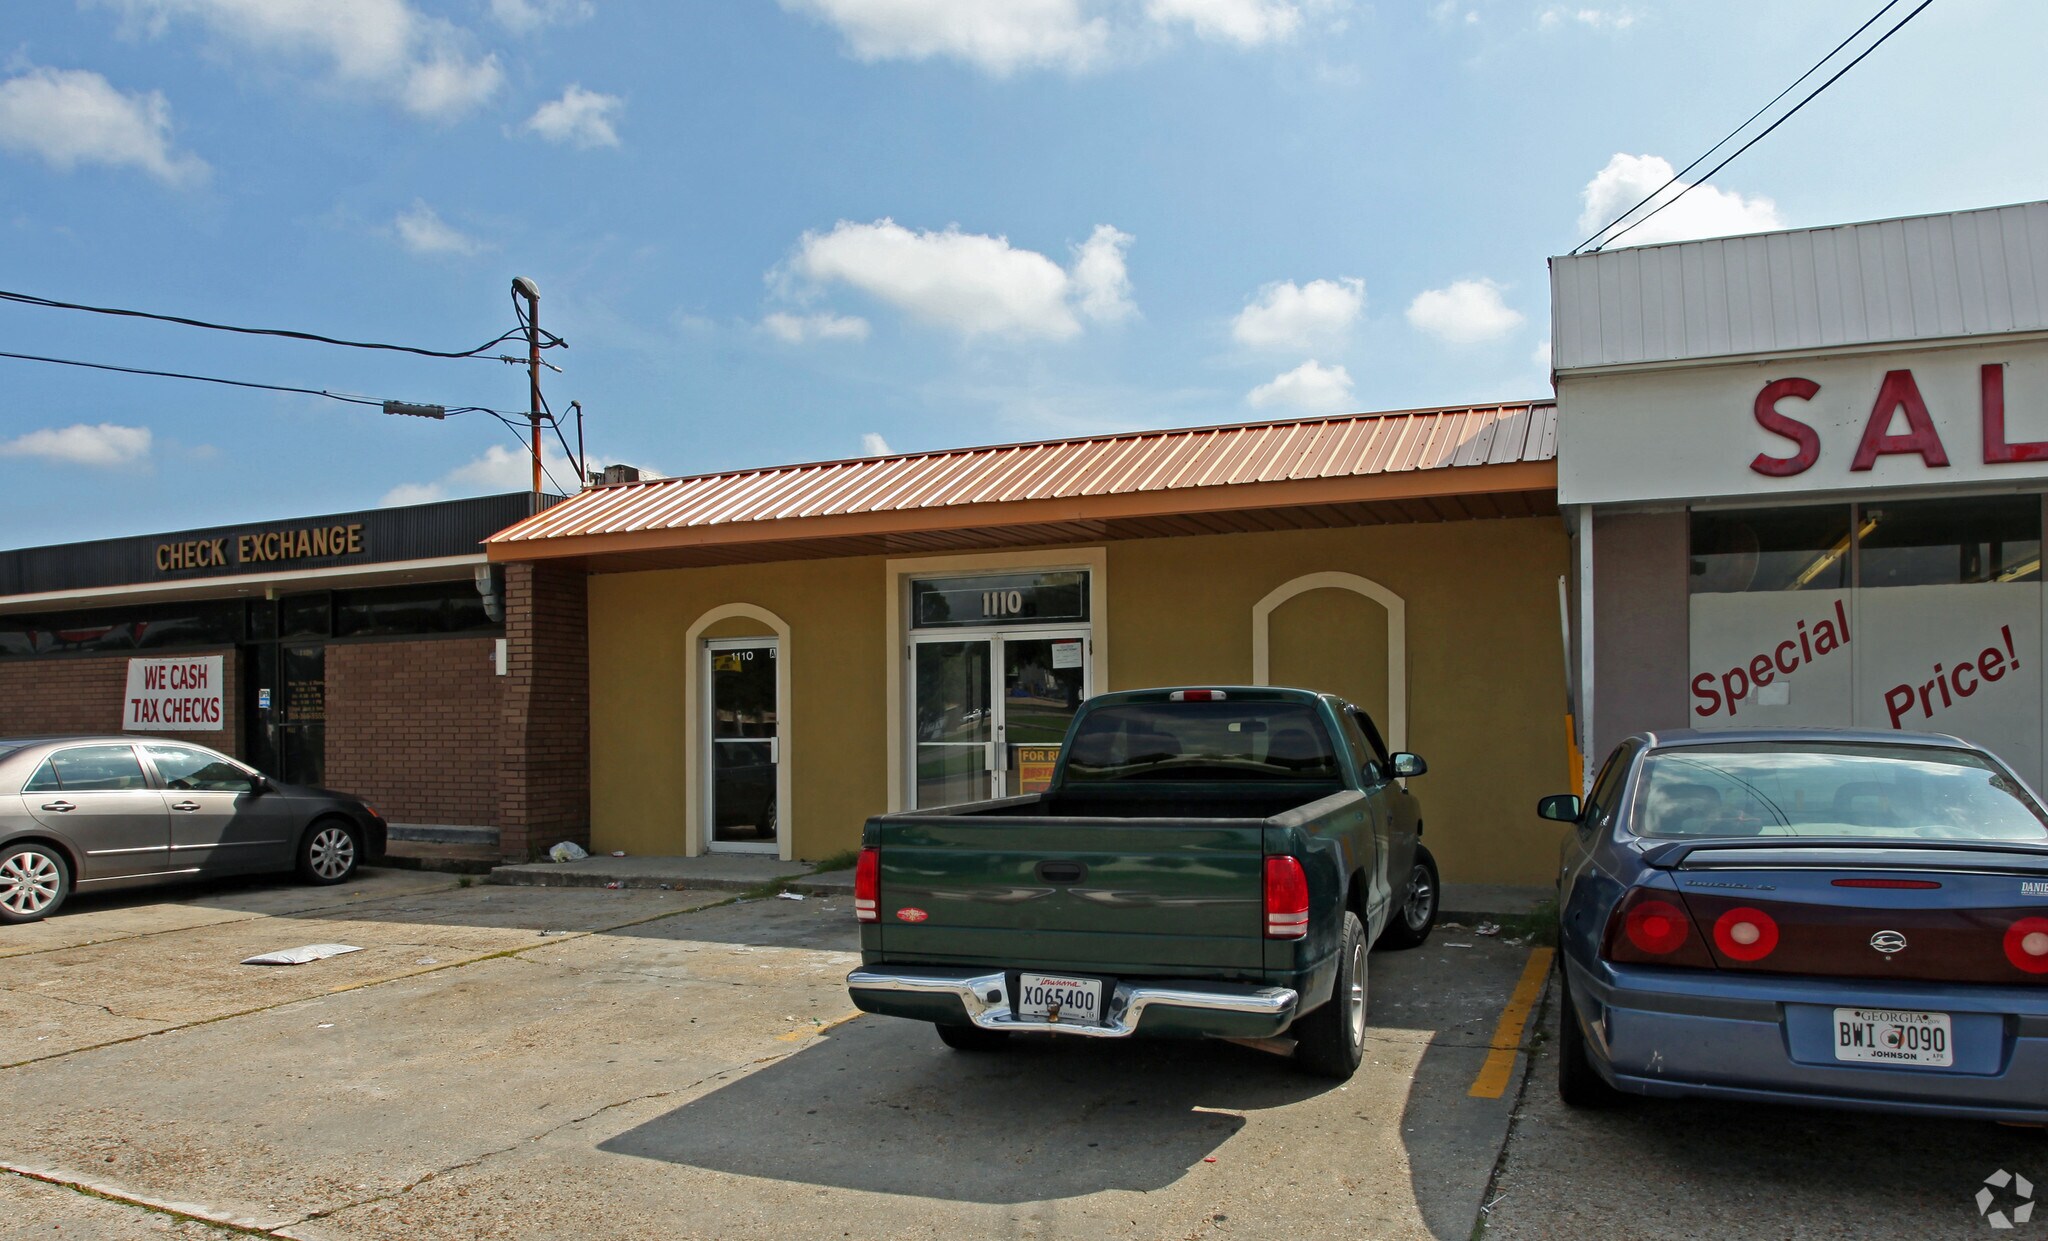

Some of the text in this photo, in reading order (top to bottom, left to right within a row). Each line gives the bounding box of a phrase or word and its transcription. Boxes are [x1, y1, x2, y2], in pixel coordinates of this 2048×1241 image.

[156, 524, 362, 571] CHECK EXCHANGE
[983, 590, 1022, 616] 1110
[731, 651, 754, 661] 1110
[1691, 599, 1850, 717] Special
[144, 664, 208, 690] WE CASH
[1884, 624, 2020, 729] Price!
[131, 697, 220, 724] TAX CHECKS
[1022, 750, 1045, 761] FOR
[1024, 986, 1094, 1010] X065400
[1840, 1022, 1945, 1052] BWI 7090
[1871, 1051, 1917, 1060] JOHNSON
